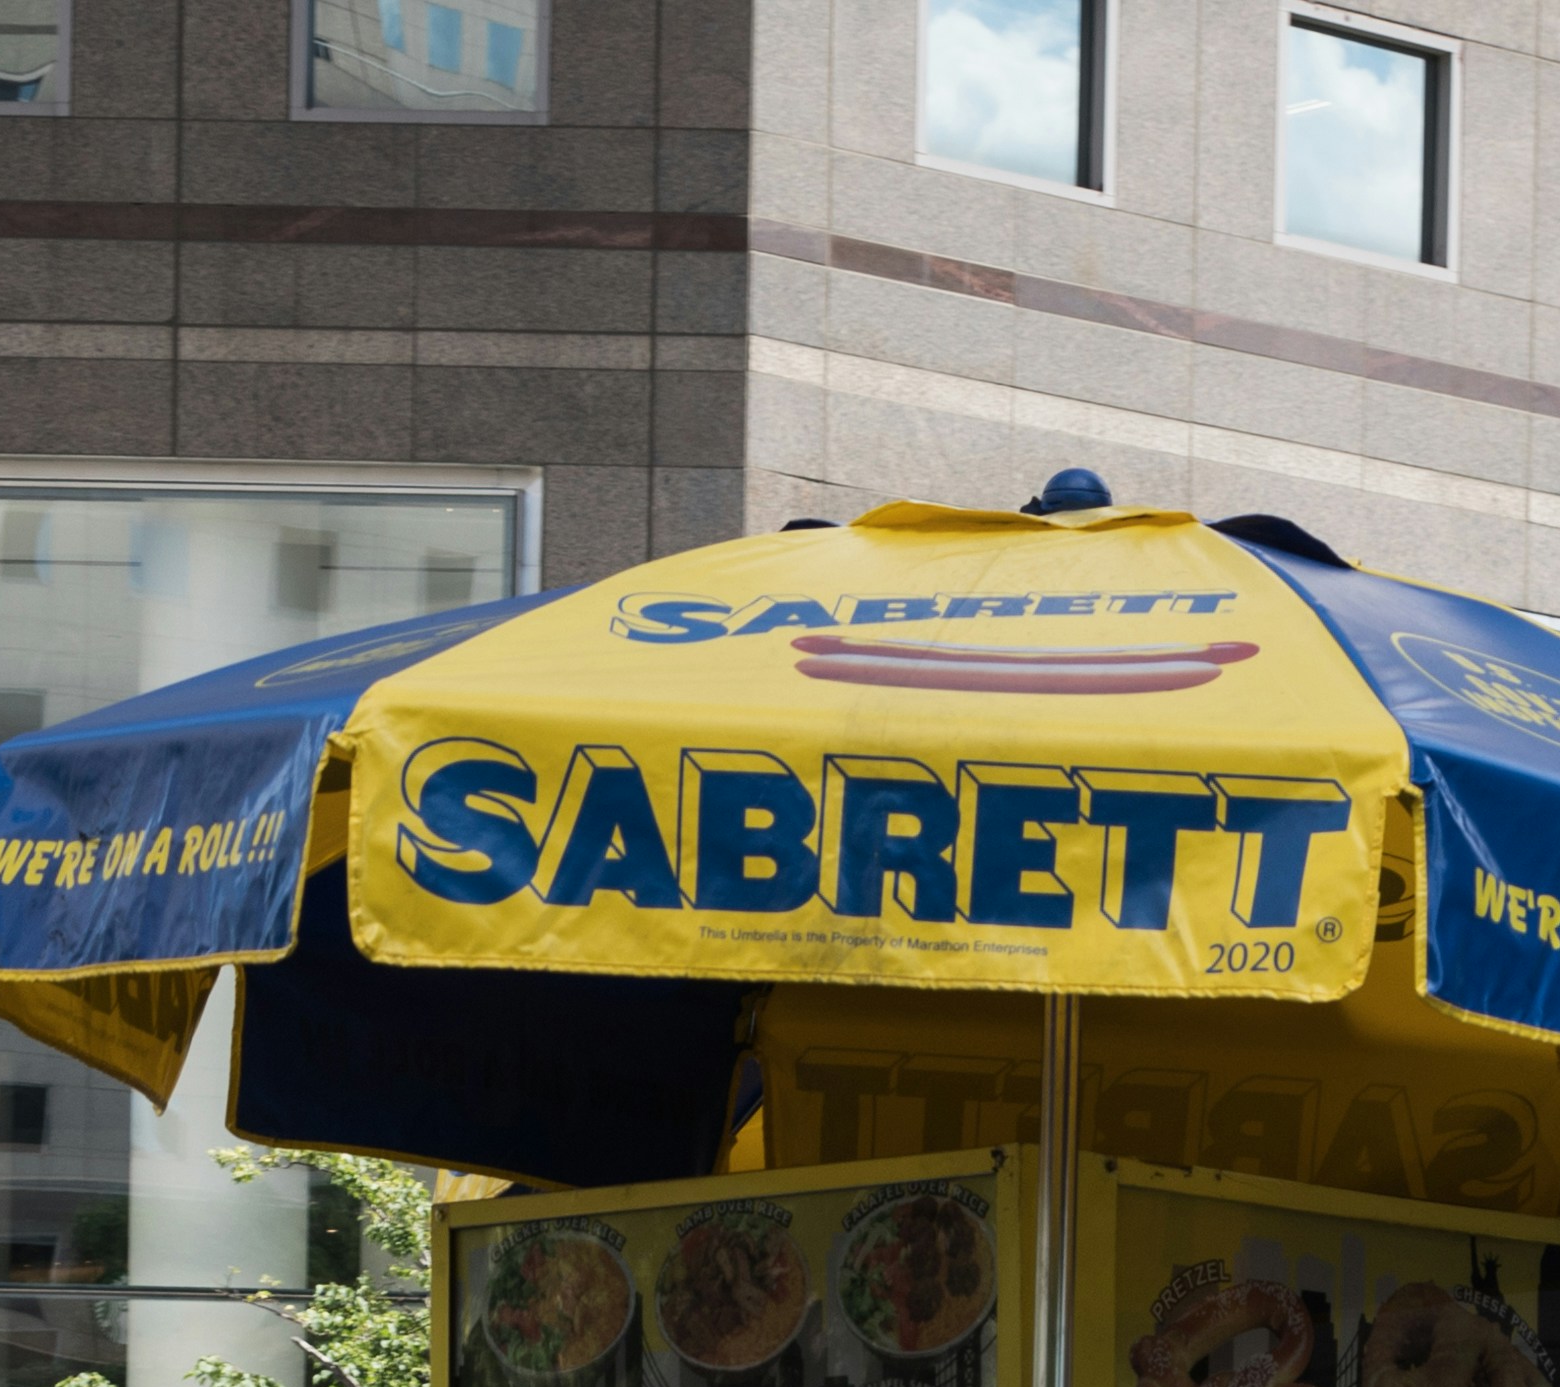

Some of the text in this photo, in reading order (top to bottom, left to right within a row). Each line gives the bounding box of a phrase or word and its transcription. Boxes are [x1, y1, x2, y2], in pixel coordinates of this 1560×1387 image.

[611, 588, 1236, 645] SABRETT
[395, 734, 1353, 931] SABRETT
[1205, 939, 1297, 975] 2020
[677, 1199, 793, 1237] LAMB OVER RICE
[843, 1178, 988, 1230] FALAFEL OVER RICE
[490, 1217, 627, 1261] CHICKEN OVER RICE
[1151, 1259, 1231, 1321] PRETZEL
[1454, 1285, 1558, 1381] CHEESE PRETZEL
